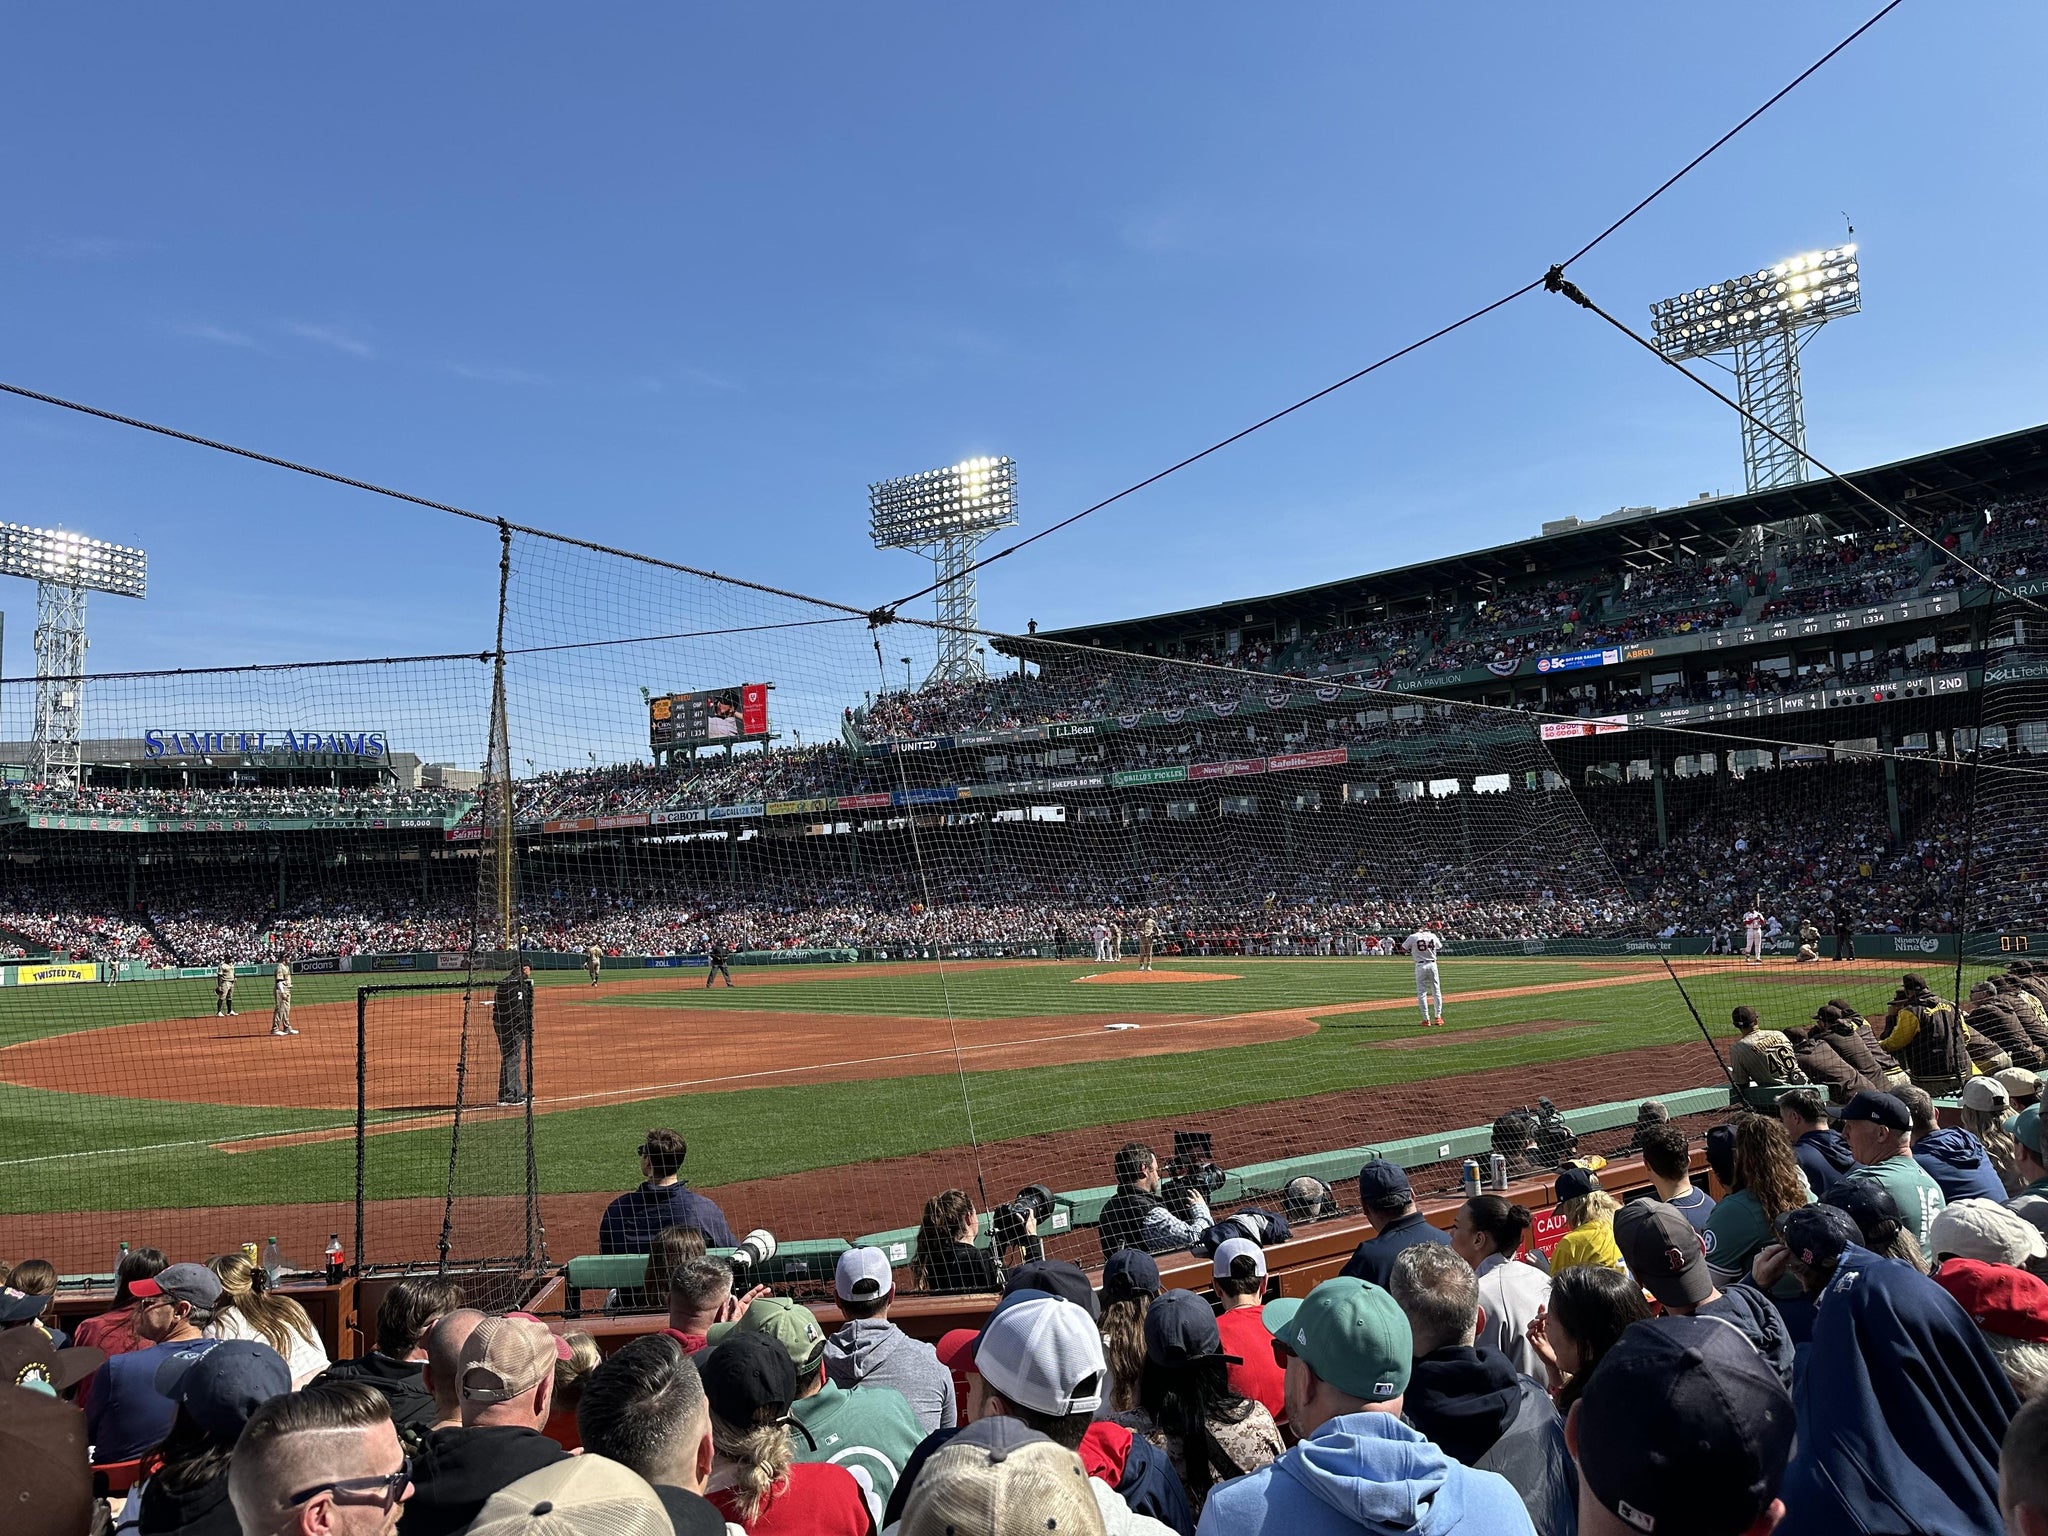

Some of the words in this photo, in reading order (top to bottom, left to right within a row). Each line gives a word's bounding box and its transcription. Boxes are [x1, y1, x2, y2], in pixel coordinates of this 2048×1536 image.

[1717, 638, 1722, 646] 6
[1744, 633, 1754, 642] 24
[1771, 629, 1787, 638] .417
[1802, 624, 1818, 633] .417
[1834, 619, 1851, 629] .917
[1863, 614, 1885, 625] 1.334
[1903, 610, 1908, 618] 3
[1935, 604, 1941, 612] 6
[1626, 648, 1654, 659] ABREU
[1984, 667, 2020, 682] DELL
[1424, 674, 1462, 687] PAVILION
[1907, 679, 1923, 688] OUT
[1939, 678, 1962, 690] 2ND
[1836, 688, 1858, 697] BALL
[1870, 683, 1897, 693] STRIKE
[1785, 699, 1804, 709] MVR
[1811, 702, 1816, 710] 4
[1634, 713, 1644, 721] 34
[1660, 710, 1671, 718] SAN
[690, 729, 705, 737] 1.334
[1056, 725, 1095, 738] L.L.Bean
[145, 729, 274, 760] SAMUEL
[280, 728, 385, 759] ADAMS
[901, 741, 937, 752] UNITED
[1270, 757, 1307, 769] Safelite
[1154, 771, 1183, 779] PICKLES
[1052, 780, 1078, 788] SWEEPER
[58, 818, 66, 829] 4
[107, 820, 123, 831] 27
[157, 821, 170, 832] 14
[258, 820, 271, 831] 42
[401, 819, 431, 827] $50,000
[559, 822, 579, 830] STIHL
[467, 830, 482, 839] PIZZ
[1894, 936, 1920, 946] Ninety
[1895, 943, 1920, 951] Nine
[770, 950, 809, 960] L.L.Bean
[300, 960, 333, 972] Jordan's
[33, 969, 67, 981] TWISTED
[68, 969, 82, 980] TEA
[1767, 1047, 1795, 1077] 46
[1665, 1248, 1685, 1271] B
